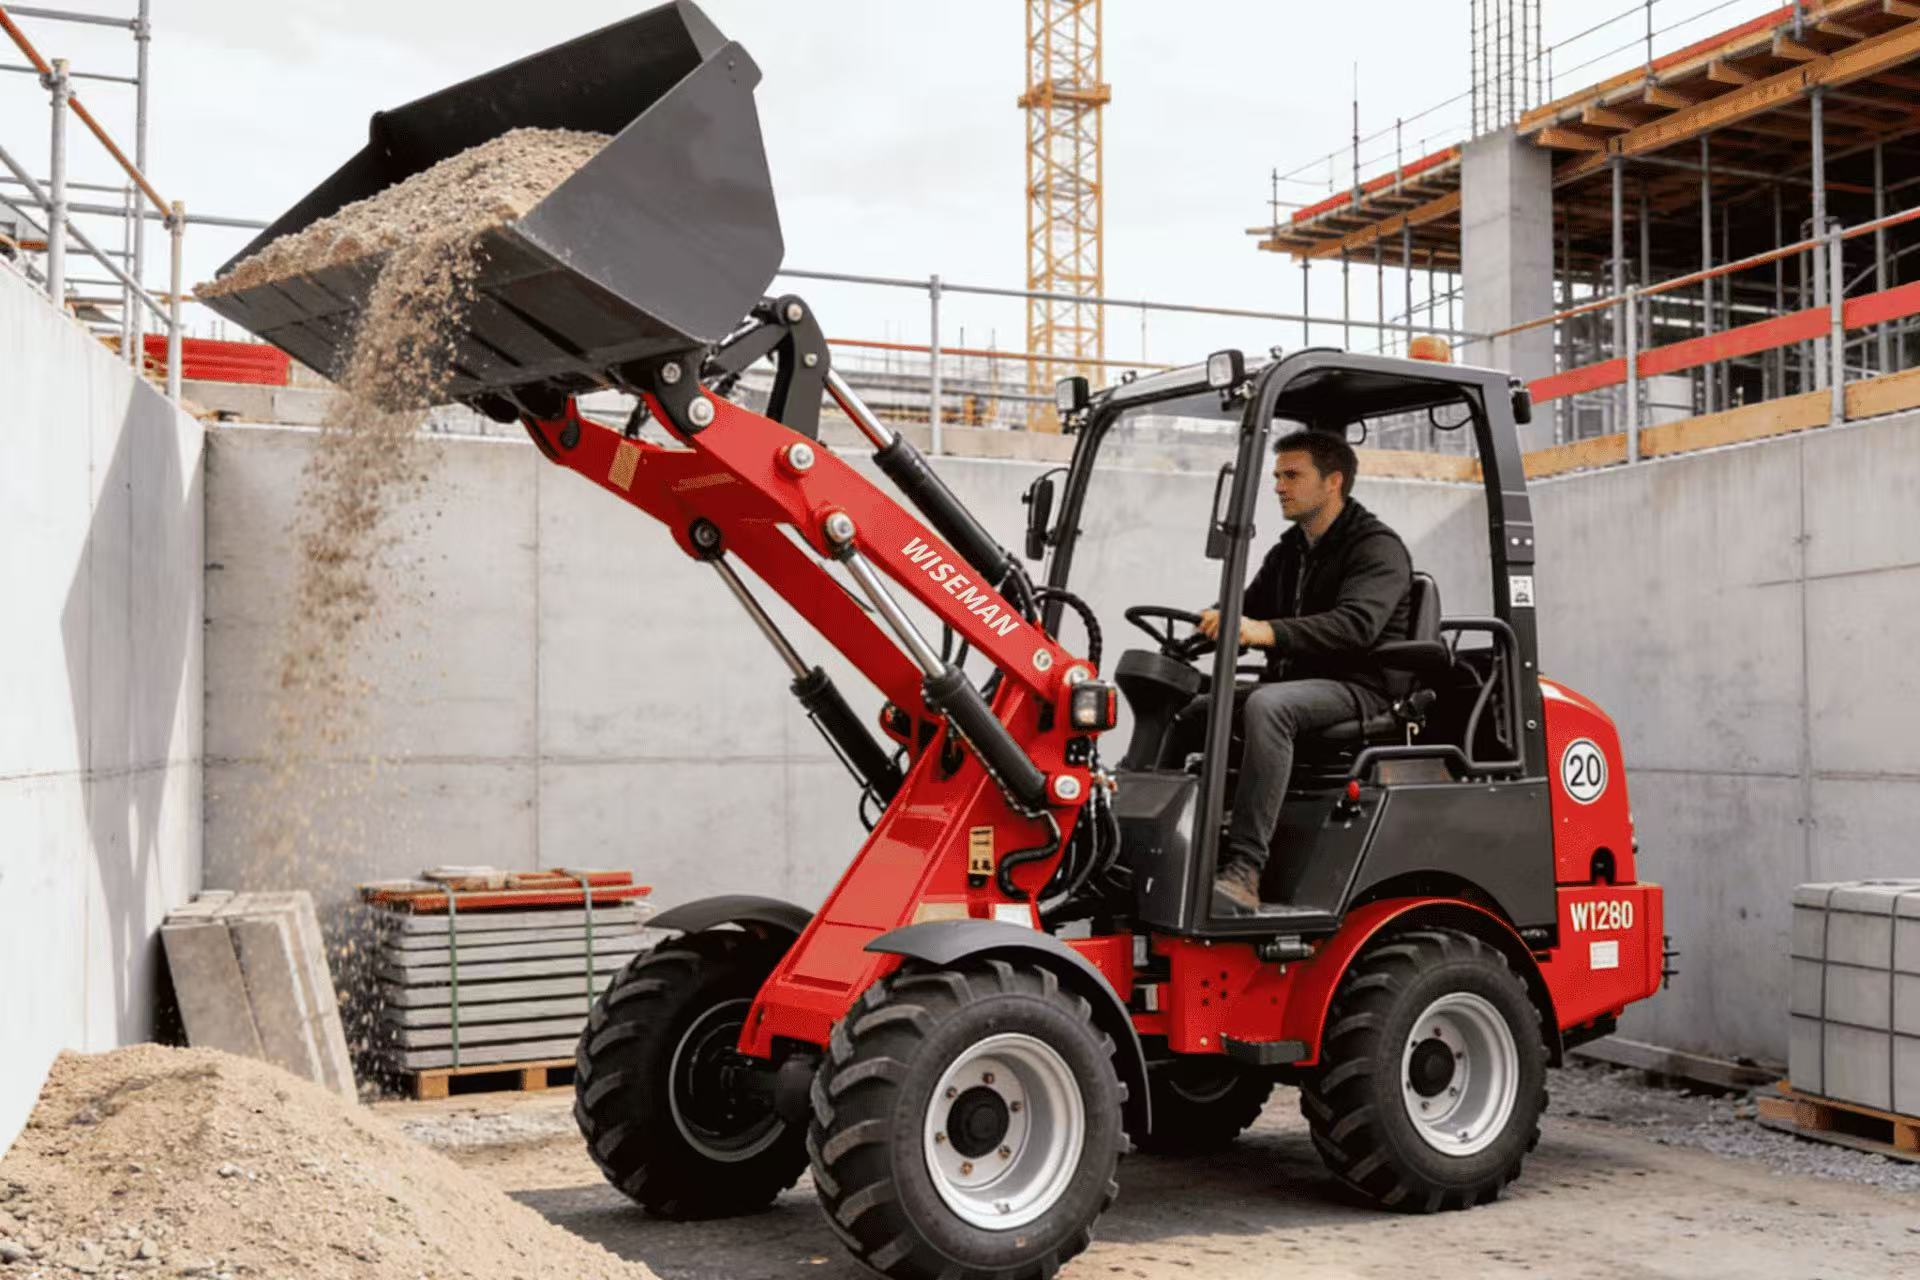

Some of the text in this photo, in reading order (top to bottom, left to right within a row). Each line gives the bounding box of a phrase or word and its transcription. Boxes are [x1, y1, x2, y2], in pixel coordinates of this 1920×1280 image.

[901, 537, 1020, 637] WISEMAN
[1570, 754, 1601, 786] 20
[1570, 900, 1633, 932] W1280
